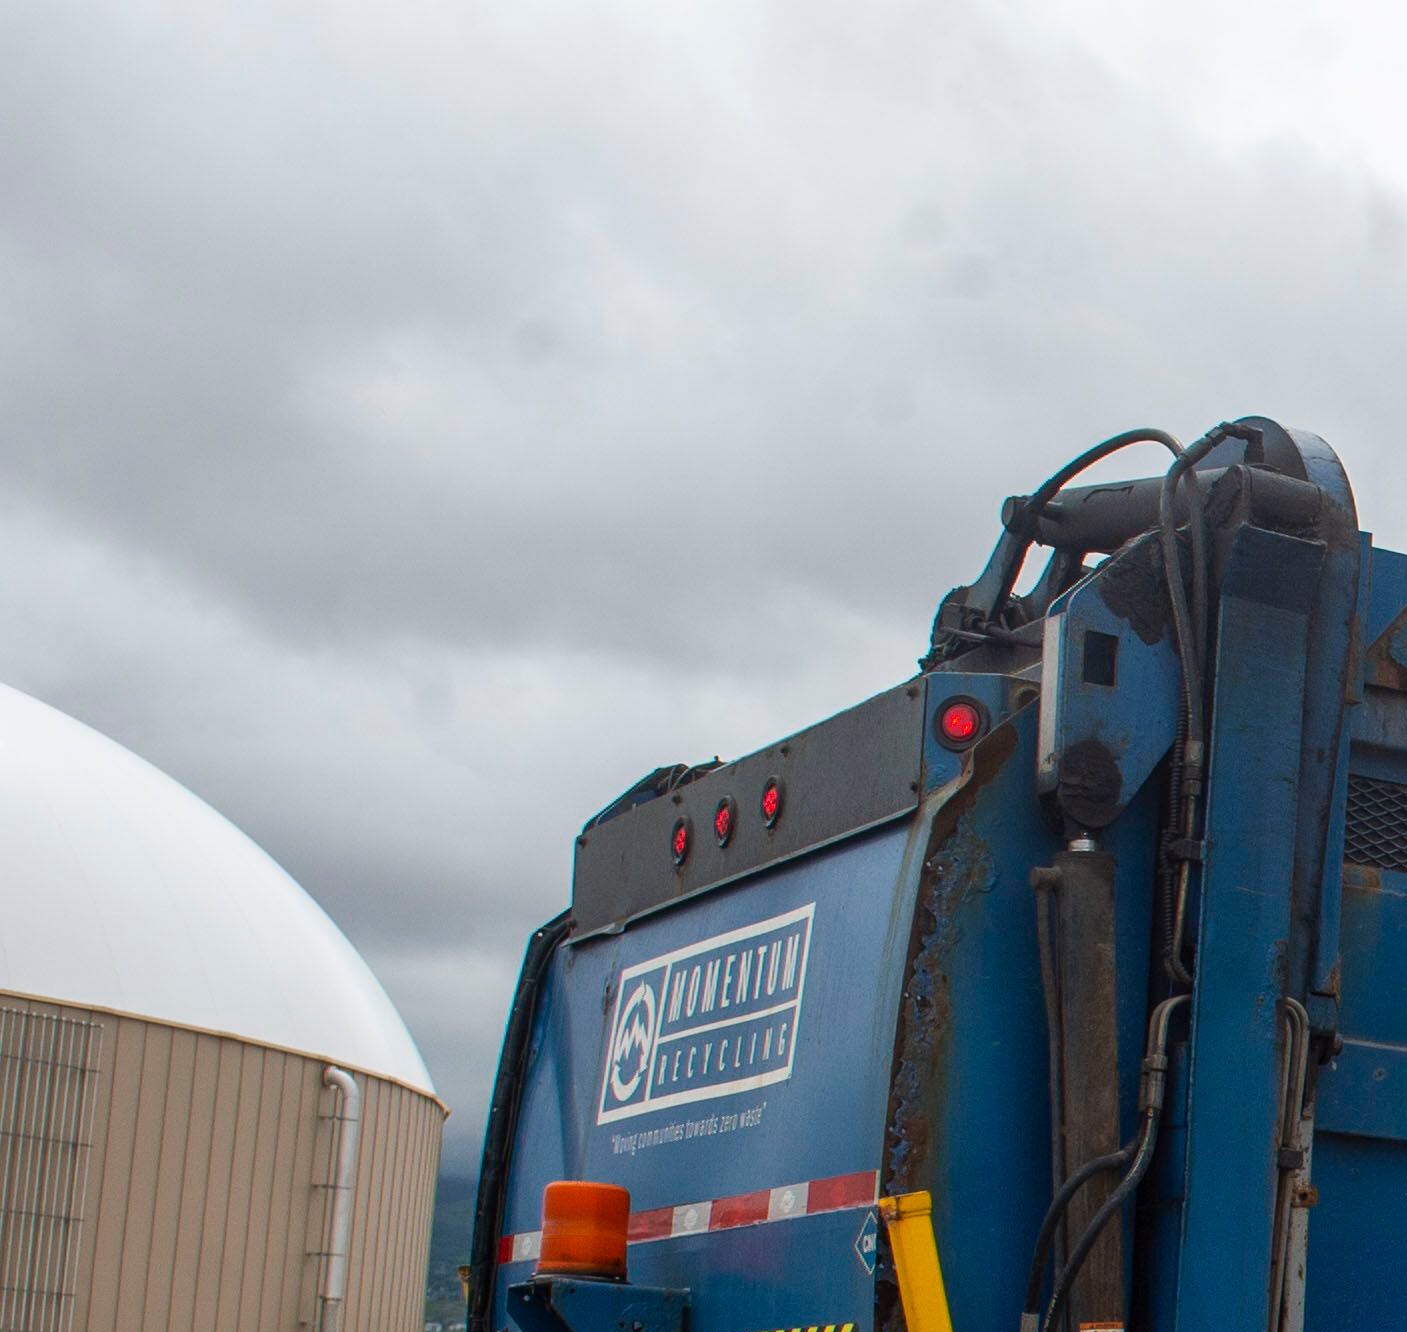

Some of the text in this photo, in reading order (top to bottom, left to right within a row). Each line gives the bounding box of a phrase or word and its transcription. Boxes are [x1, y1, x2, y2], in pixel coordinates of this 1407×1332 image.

[668, 933, 800, 1023] MOMENTUM
[658, 1022, 788, 1085] RECYCLING
[685, 1113, 719, 1139] towards
[719, 1113, 738, 1133] zero
